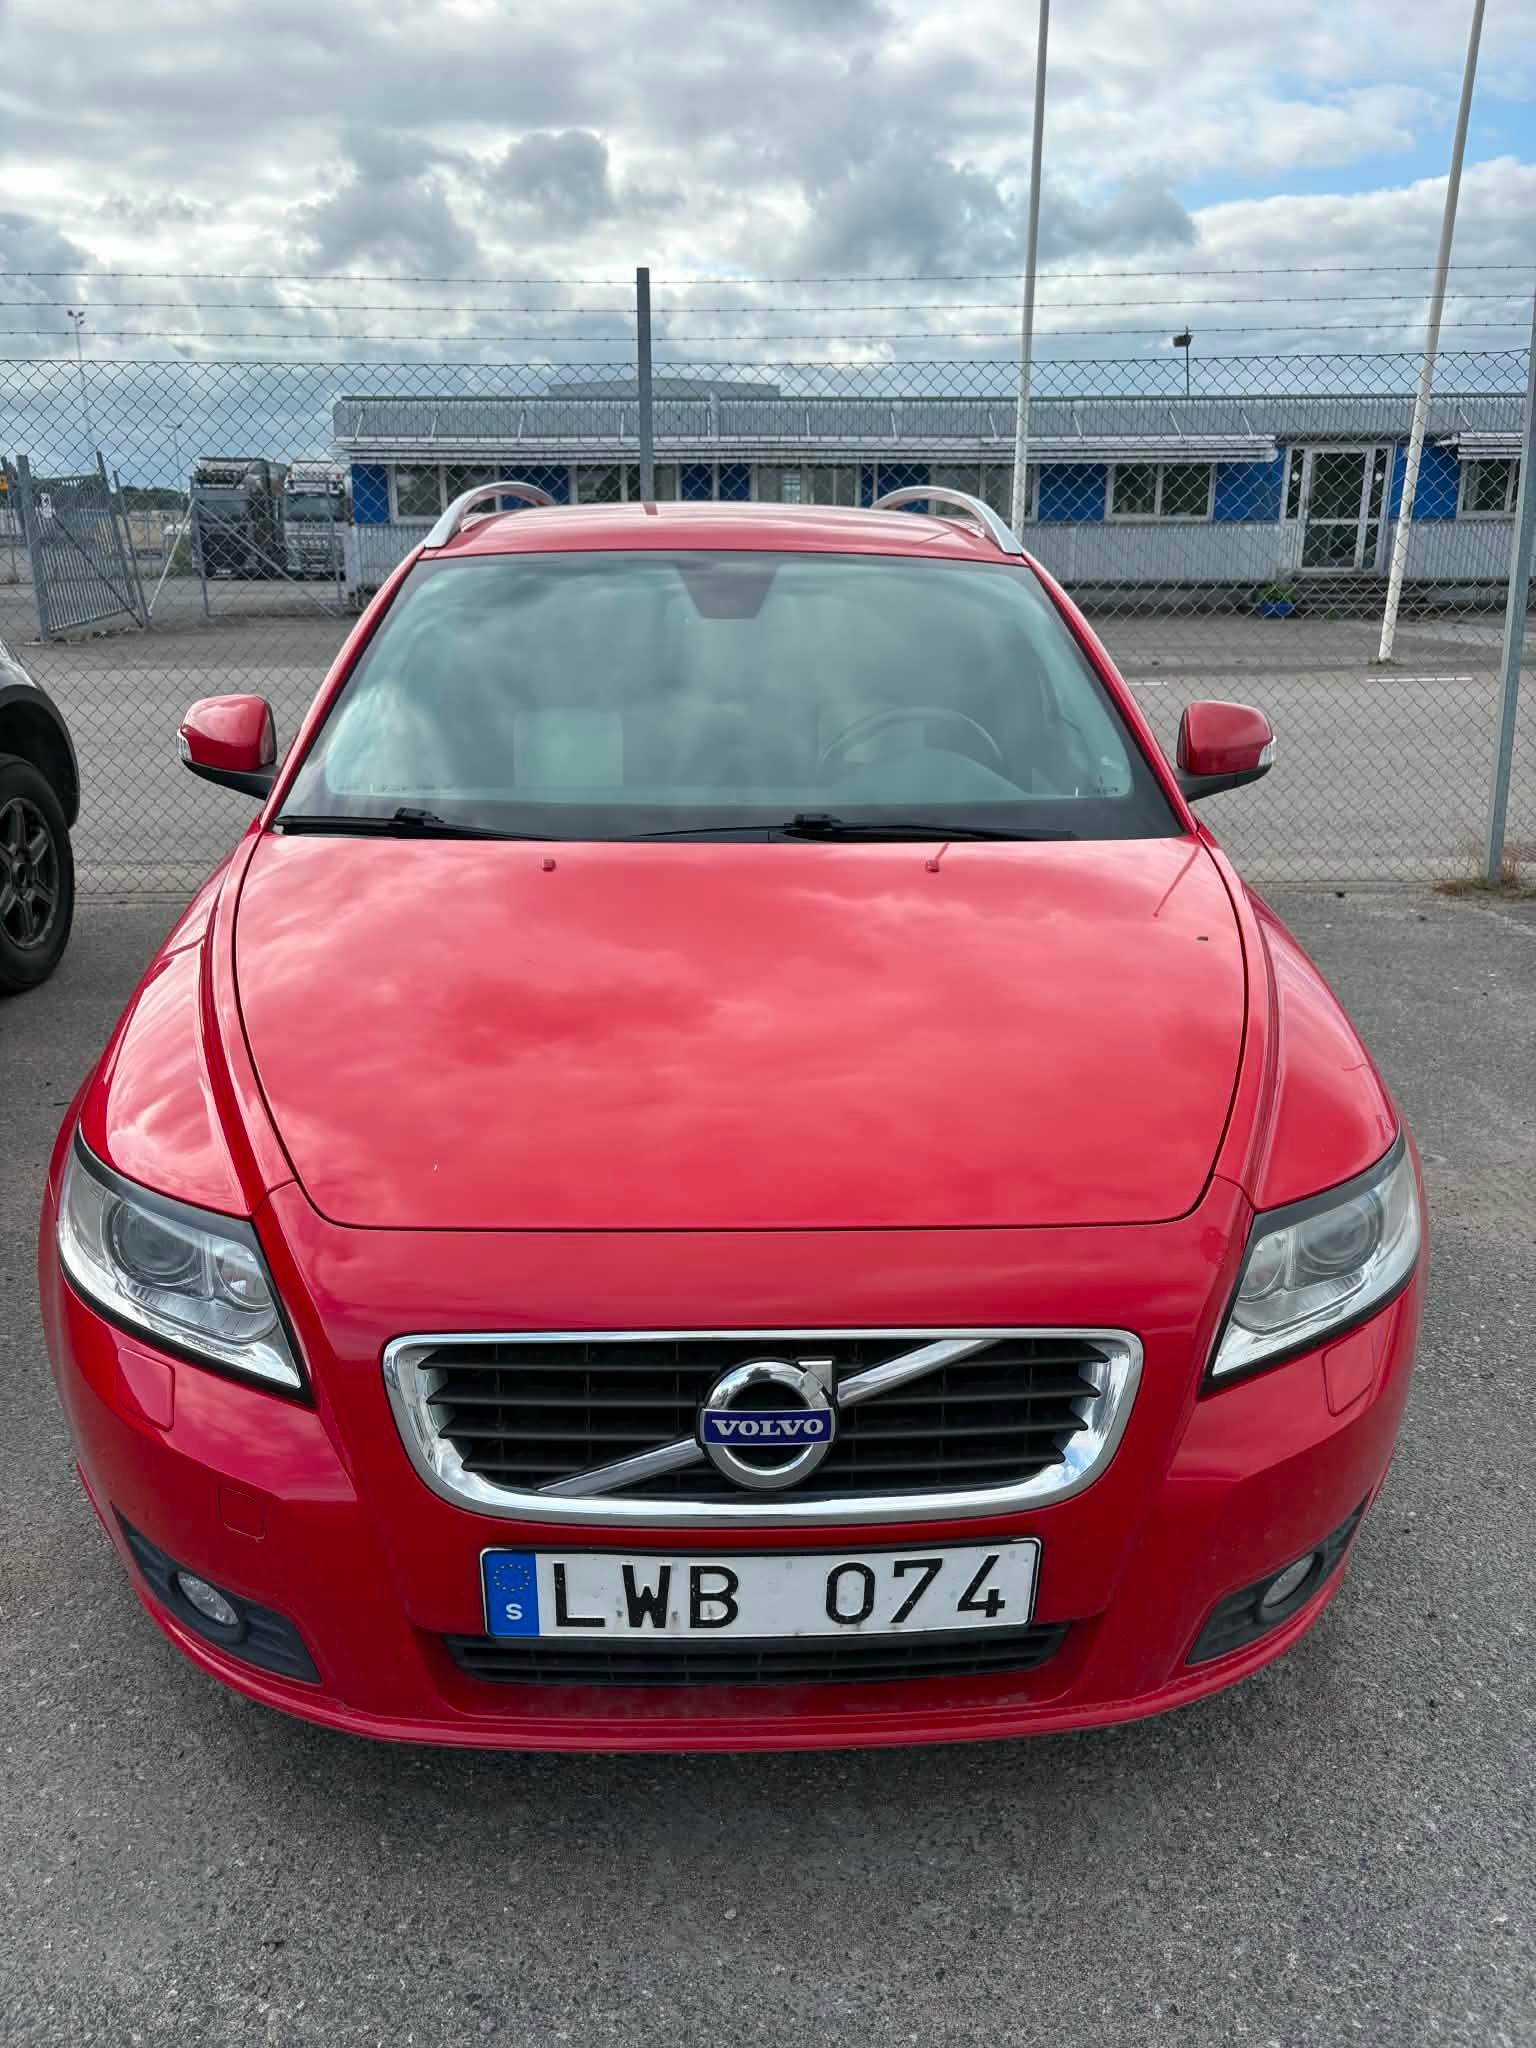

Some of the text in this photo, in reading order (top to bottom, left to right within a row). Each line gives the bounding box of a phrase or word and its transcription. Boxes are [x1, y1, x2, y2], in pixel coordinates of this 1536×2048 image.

[711, 1418, 824, 1436] VOLVO
[553, 1554, 1006, 1629] LWB 074
[505, 1602, 523, 1621] S
